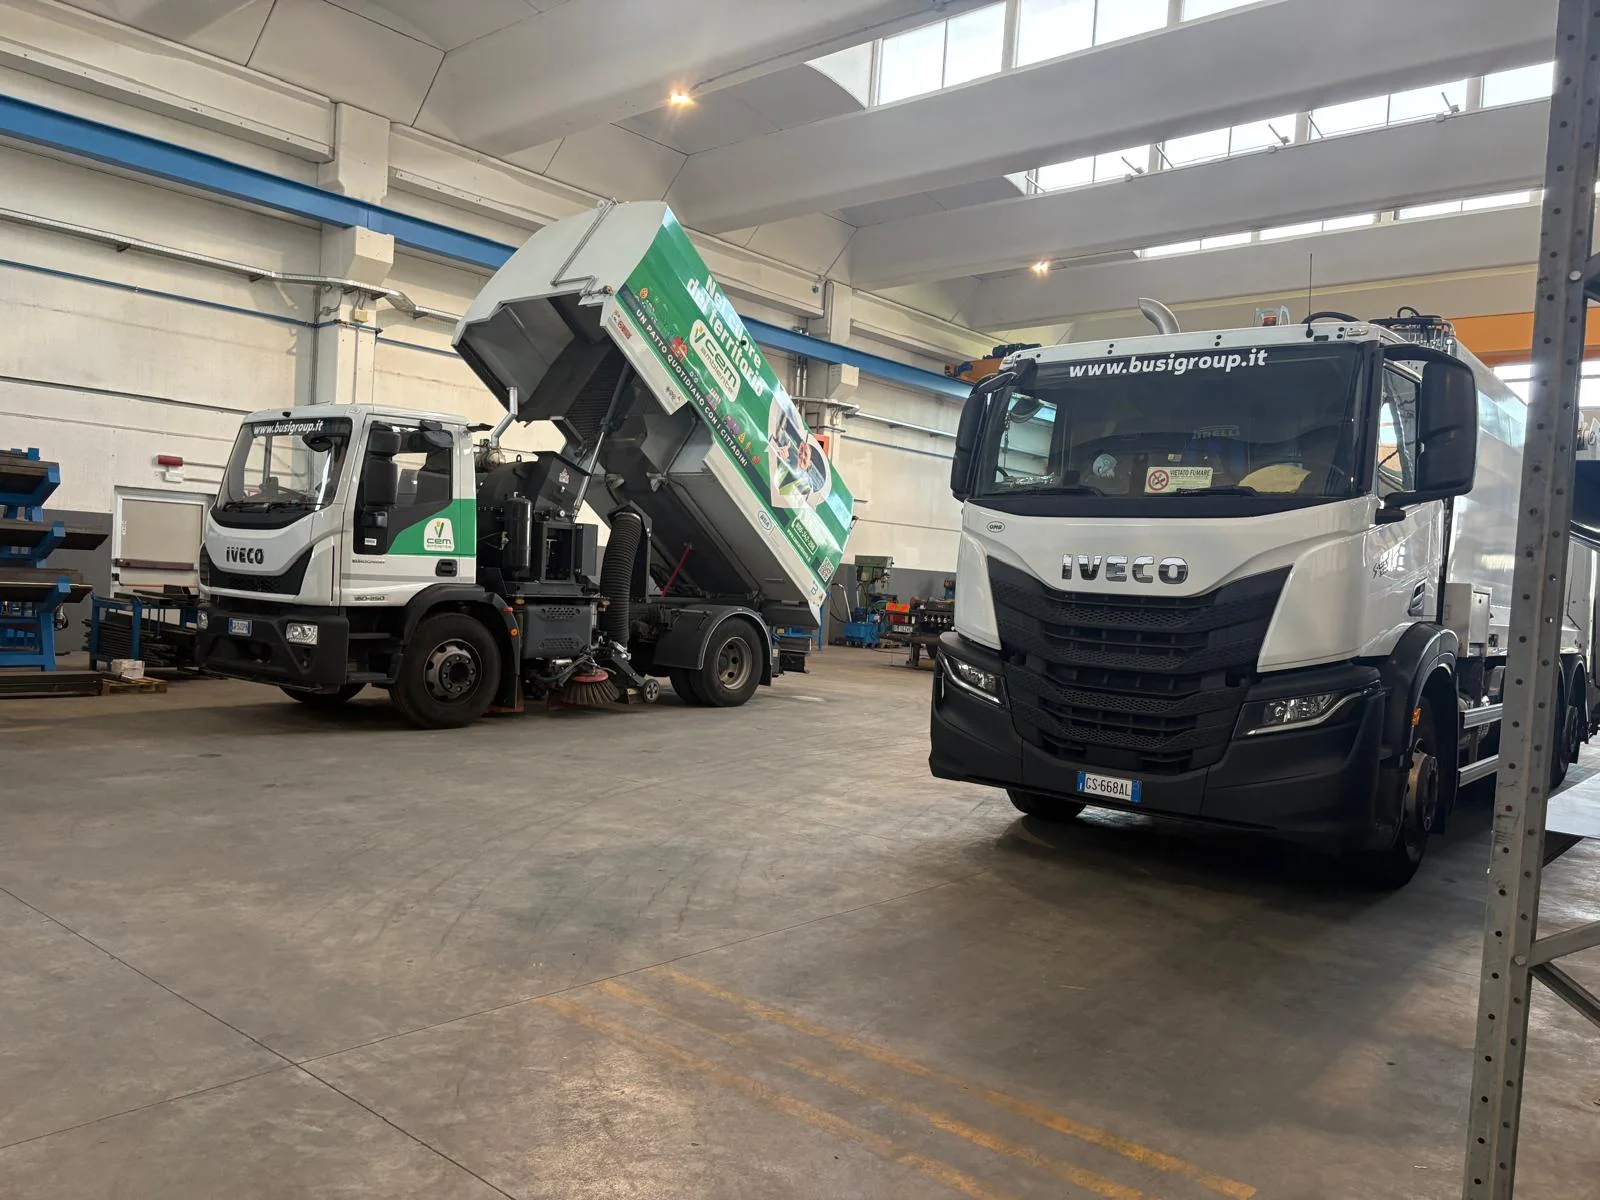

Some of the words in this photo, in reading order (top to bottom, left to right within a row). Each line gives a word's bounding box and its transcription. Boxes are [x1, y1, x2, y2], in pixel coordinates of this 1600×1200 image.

[704, 338, 737, 388] cem
[708, 307, 764, 397] territorio
[1069, 348, 1268, 376] www.busigroup.it
[636, 309, 647, 324] UN
[646, 324, 668, 353] PATTO
[667, 354, 705, 406] QUOTIDIANO
[704, 406, 718, 424] CON
[720, 429, 748, 466] CITTADINI
[253, 419, 324, 435] www.busigroup.it
[226, 546, 264, 565] IVECO
[1061, 553, 1189, 584] IVECO
